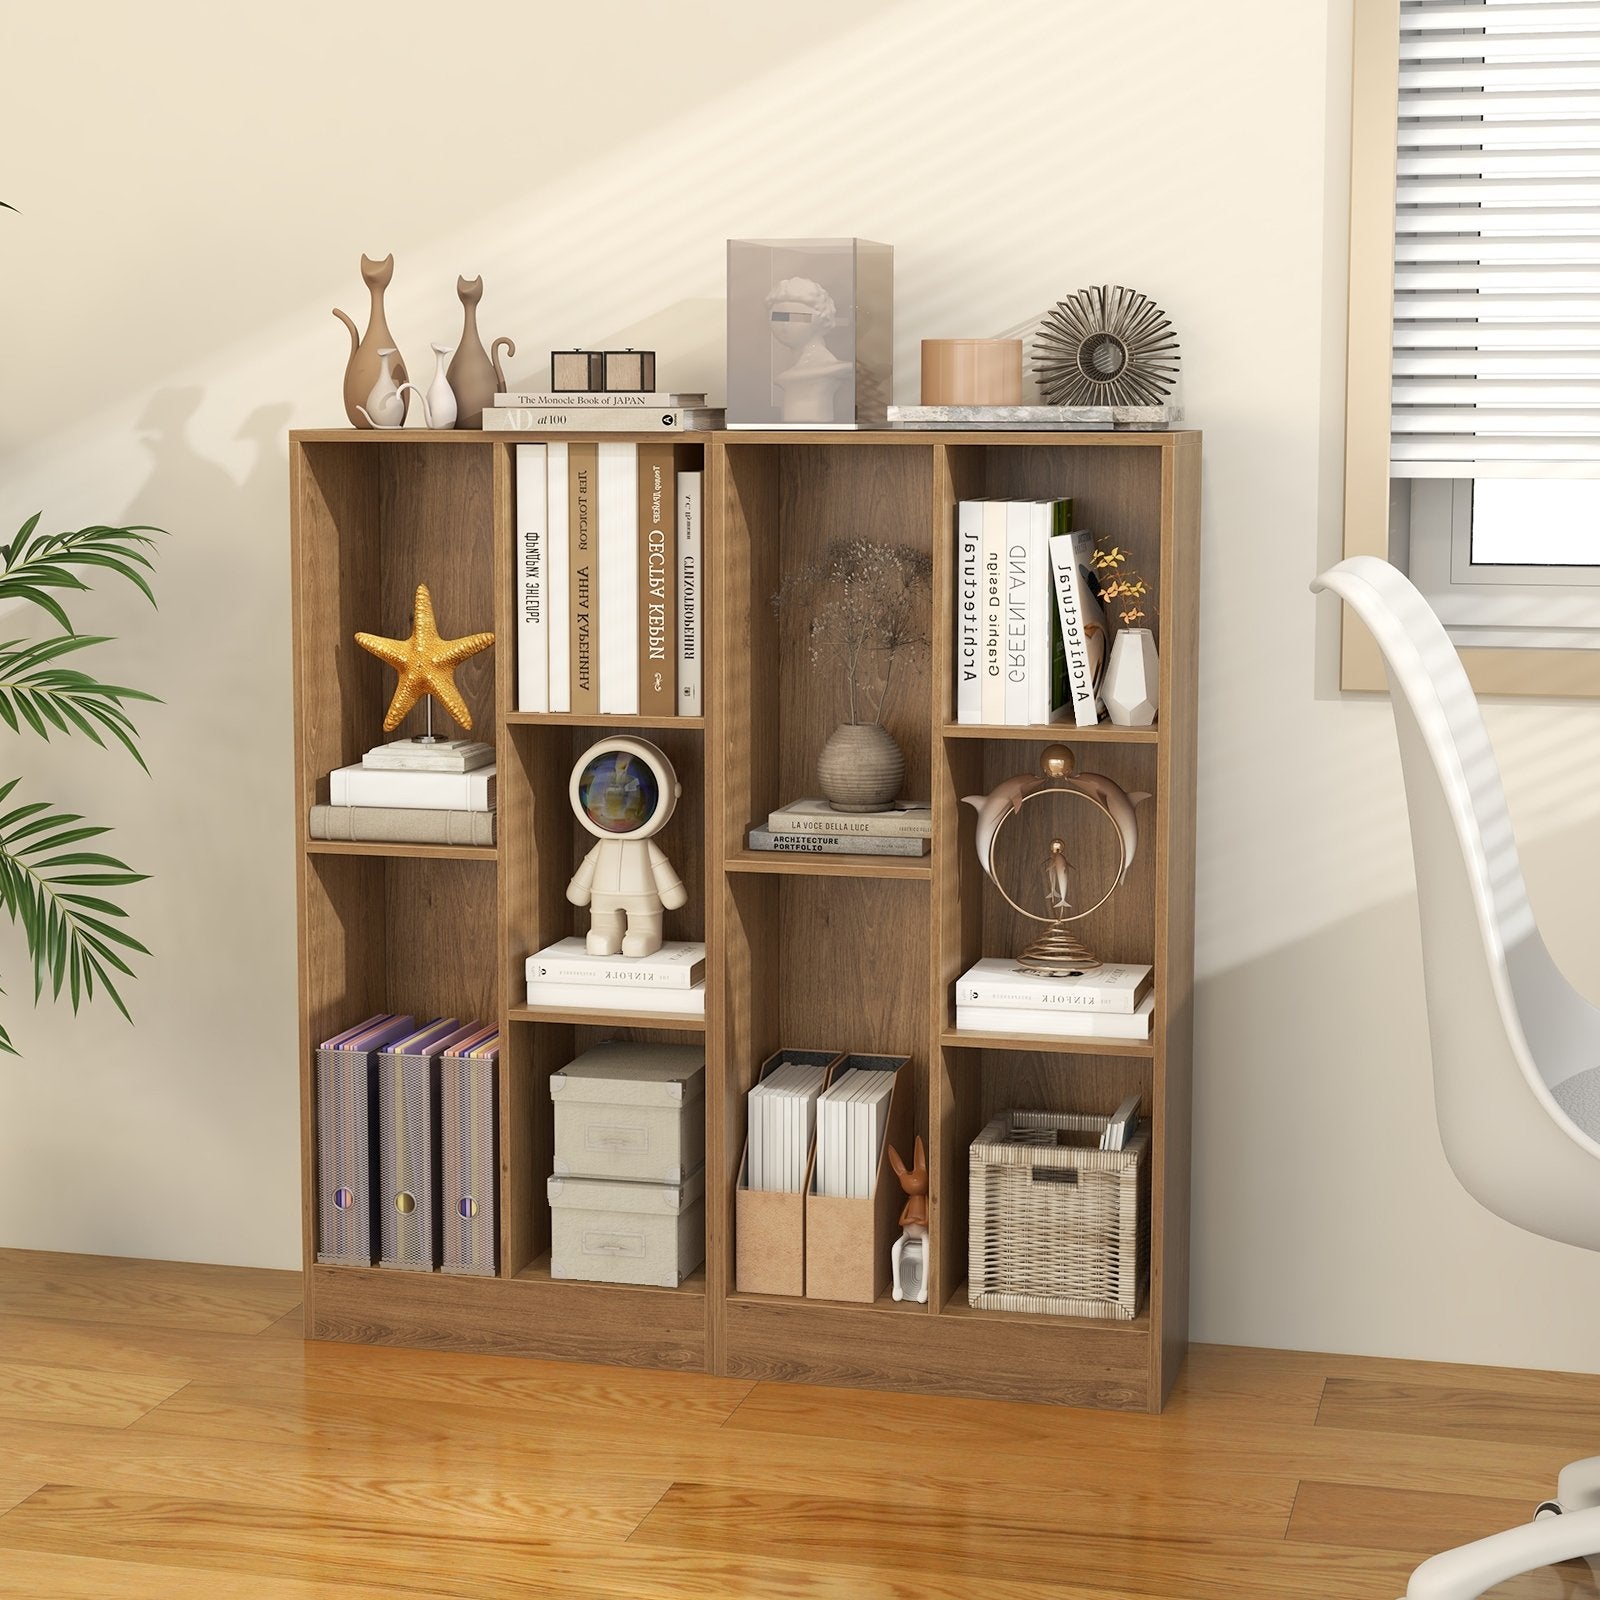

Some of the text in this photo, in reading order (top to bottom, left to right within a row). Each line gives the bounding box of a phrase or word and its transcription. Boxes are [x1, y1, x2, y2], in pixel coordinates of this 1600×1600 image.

[518, 395, 645, 406] The Monocle Book of JAPAN
[502, 410, 566, 430] AD at 100
[792, 821, 869, 832] LA VOCE DELLA LUCE
[773, 836, 839, 845] ARCHITECTURE
[774, 843, 823, 851] PORTFOLIO
